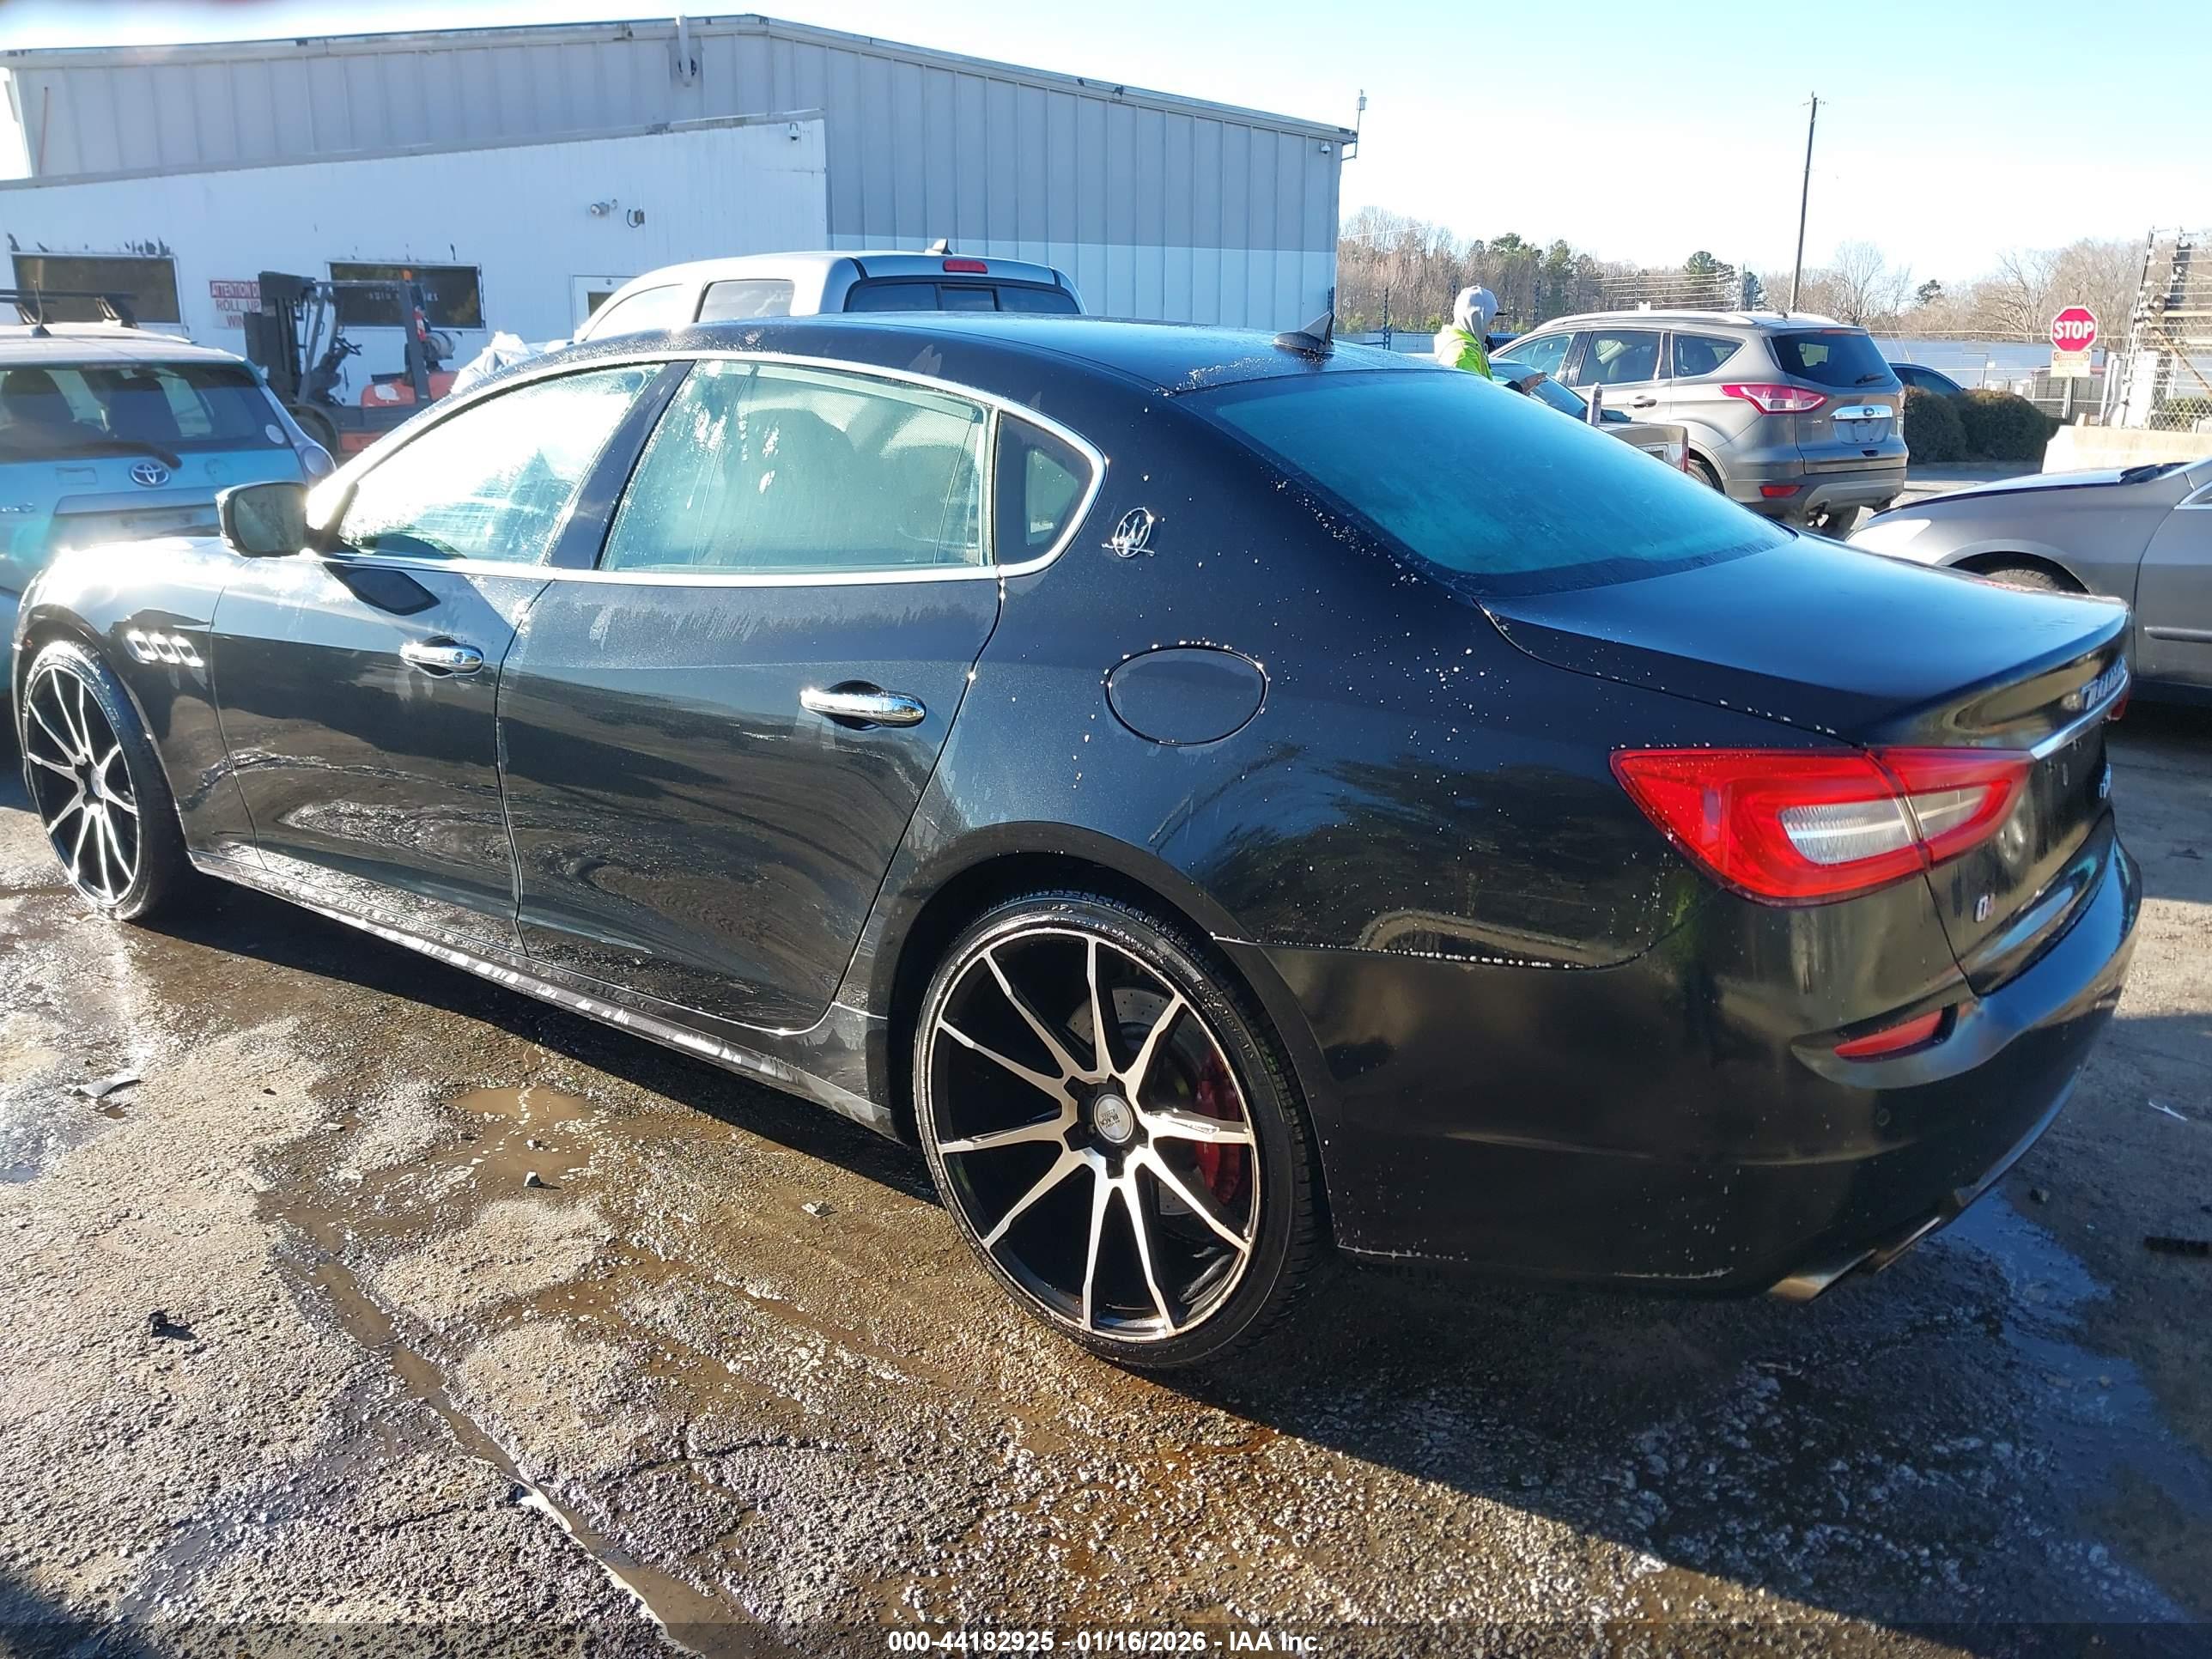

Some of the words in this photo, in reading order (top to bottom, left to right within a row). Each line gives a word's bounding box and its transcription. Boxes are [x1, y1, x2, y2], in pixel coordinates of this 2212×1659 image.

[216, 300, 241, 312] ROLL
[246, 301, 261, 313] UP
[2053, 320, 2094, 340] STOP
